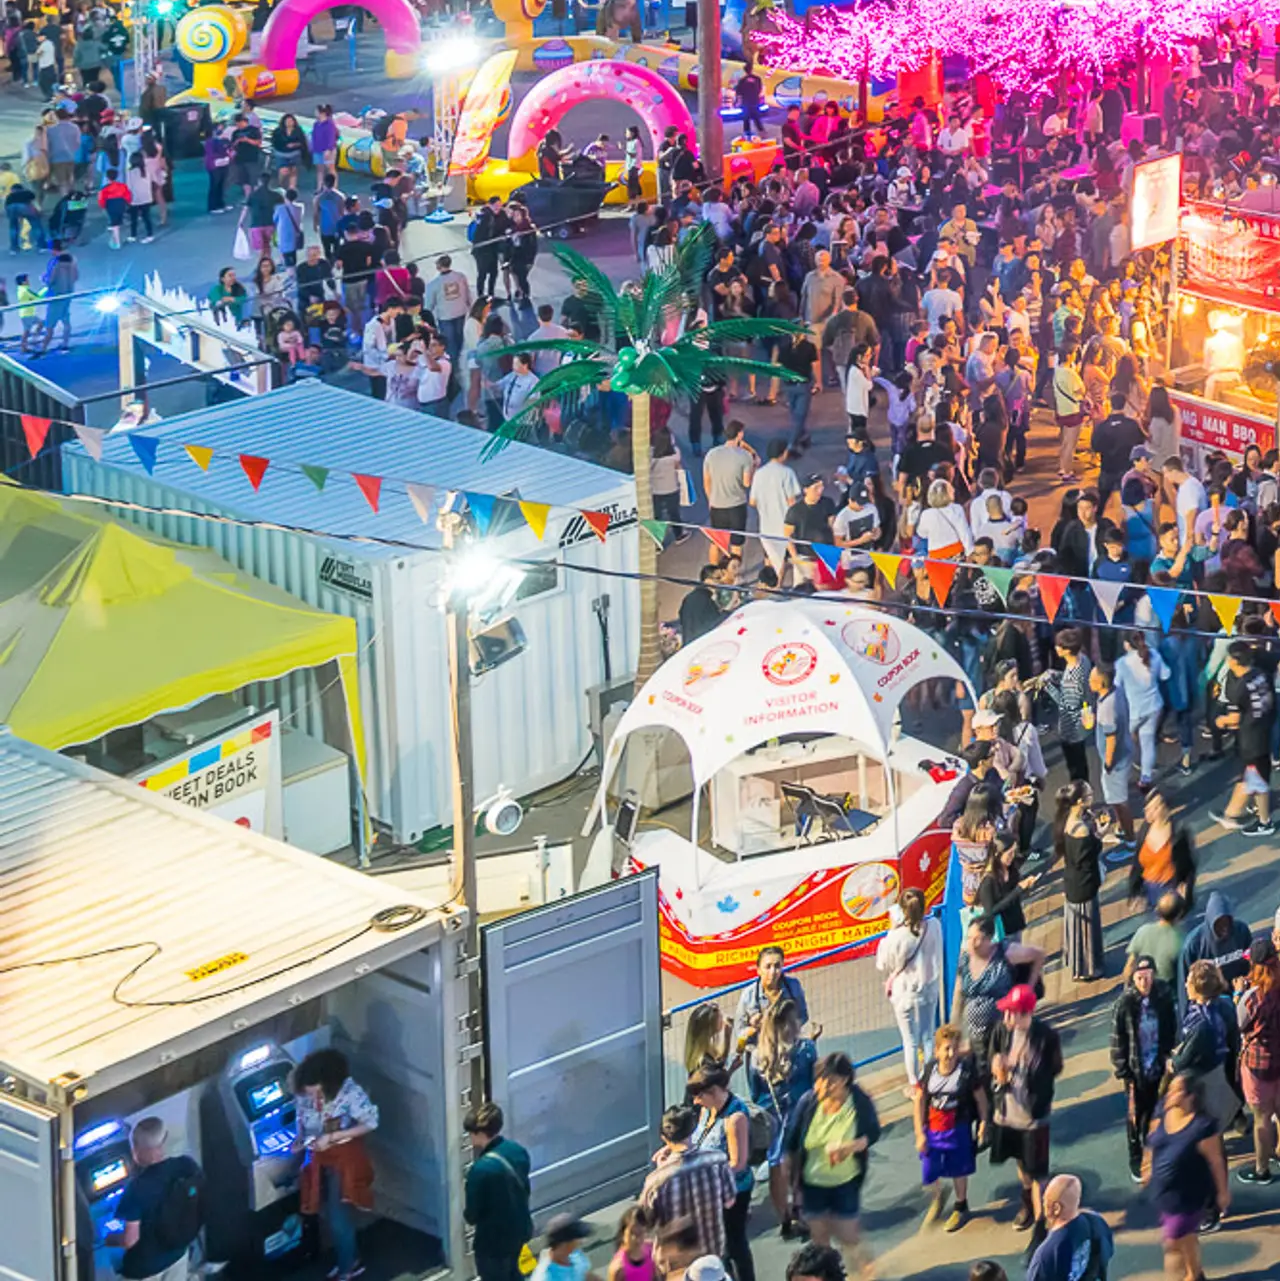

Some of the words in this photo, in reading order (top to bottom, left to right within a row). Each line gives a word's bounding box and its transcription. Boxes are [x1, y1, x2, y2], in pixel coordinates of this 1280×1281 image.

[1202, 415, 1228, 436] MAN
[1232, 422, 1257, 444] BBQ
[662, 690, 686, 709] COUPON
[765, 691, 817, 708] VISITOR
[743, 701, 839, 726] INFORMATION
[164, 776, 202, 801] EET
[205, 751, 255, 786] DEALS
[214, 765, 258, 799] BOOK
[772, 916, 812, 931] COUPON
[813, 911, 840, 922] BOOK
[794, 932, 837, 948] NIGHT
[843, 921, 890, 939] MARKE
